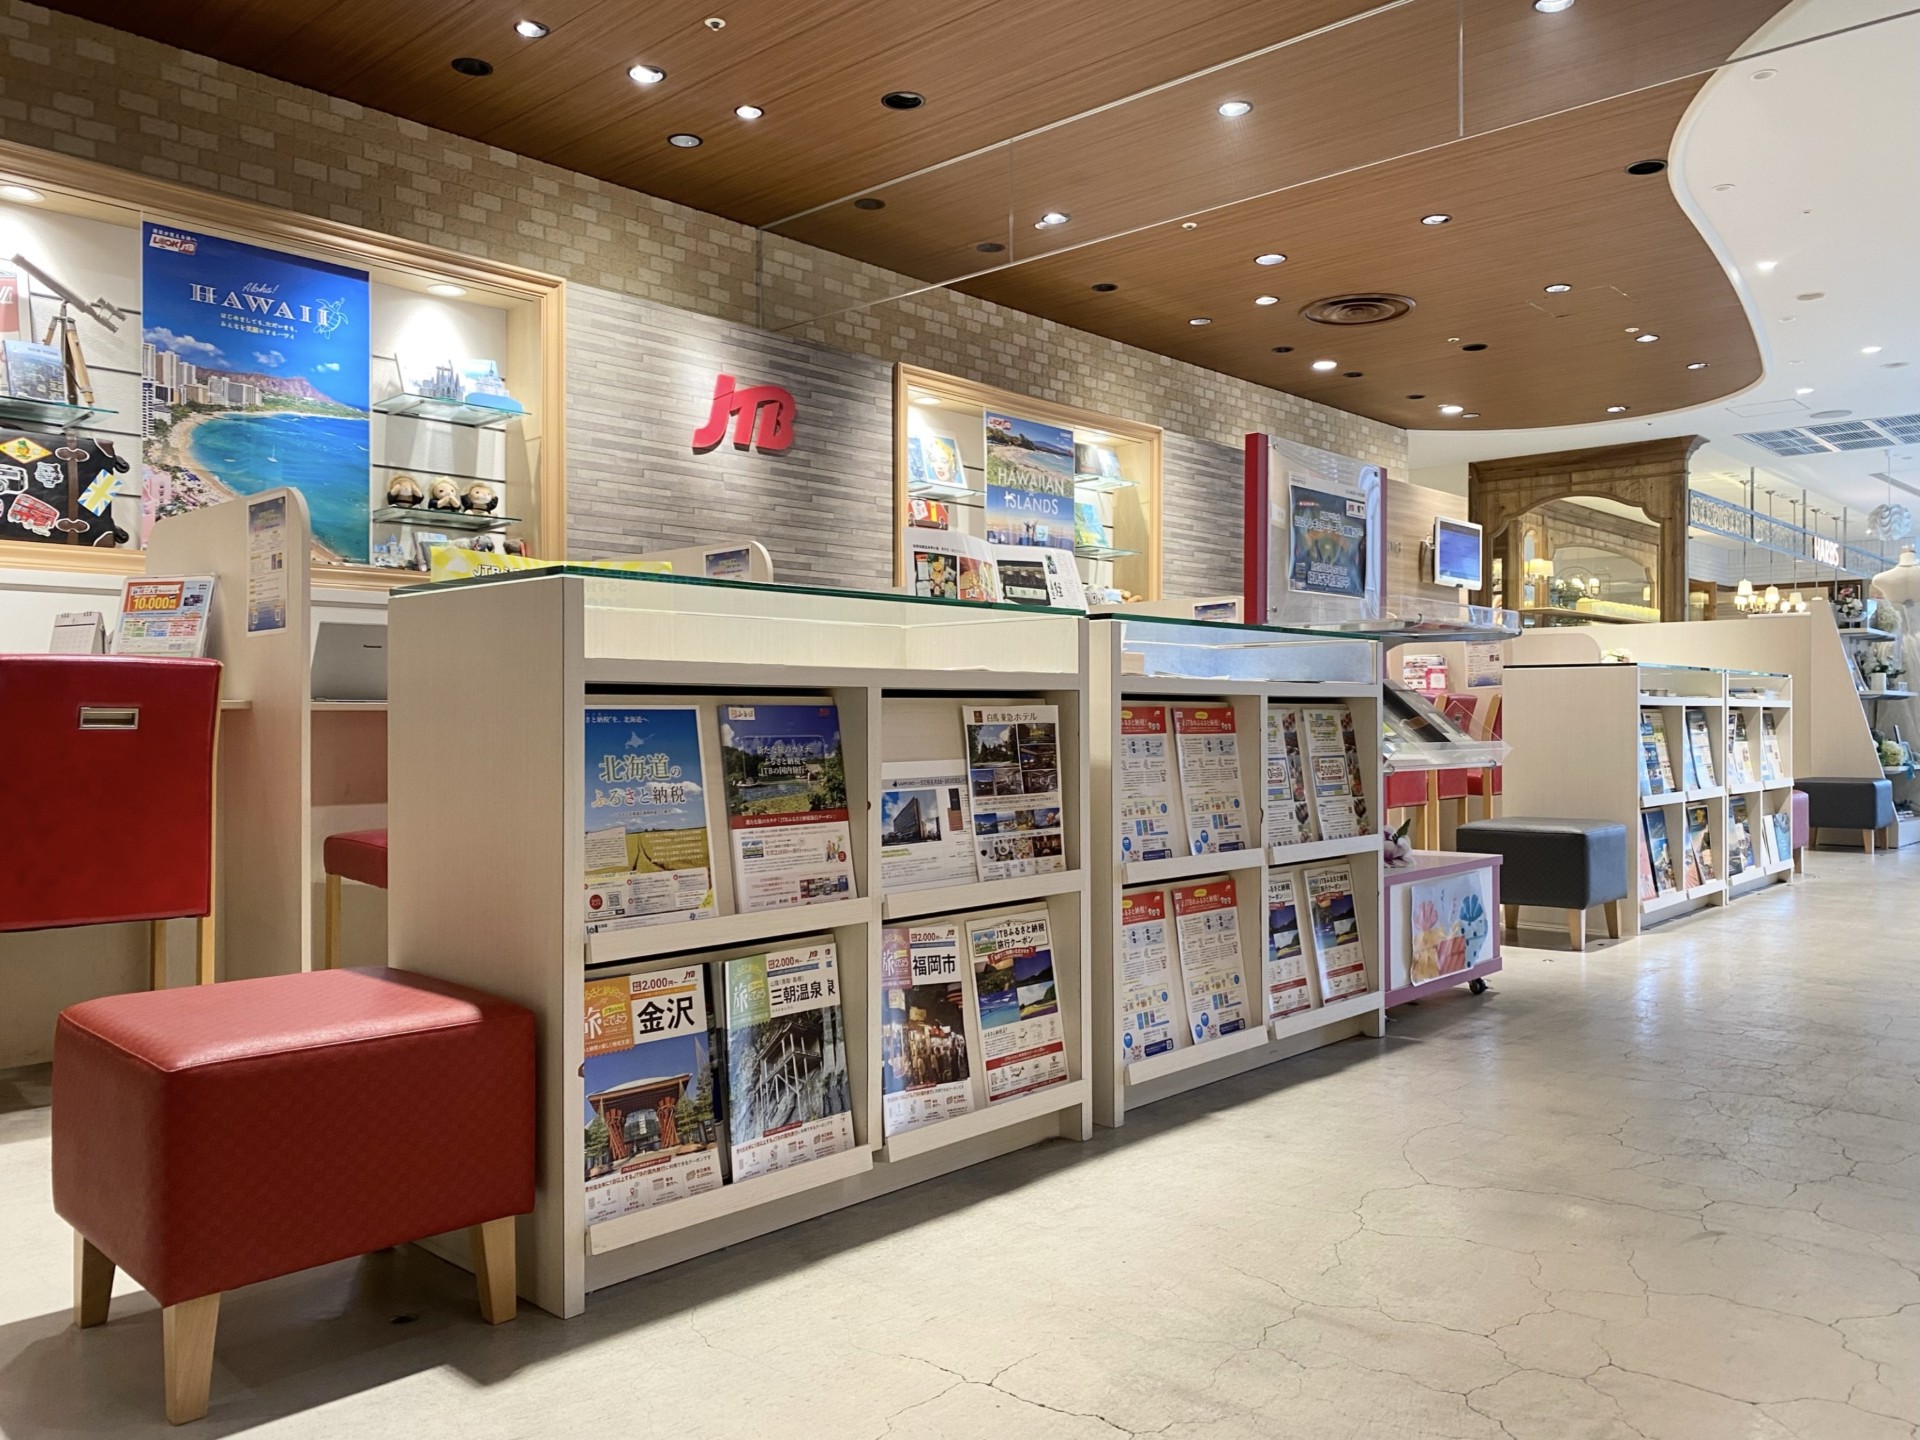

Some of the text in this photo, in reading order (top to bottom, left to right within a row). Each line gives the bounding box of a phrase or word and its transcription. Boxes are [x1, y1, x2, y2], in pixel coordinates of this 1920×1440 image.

[241, 282, 280, 295] Aloha!
[189, 283, 330, 327] HAWAII
[691, 373, 797, 456] JTB
[998, 467, 1065, 496] HAWAIIAN
[1004, 490, 1059, 515] ISLANDS
[1814, 535, 1840, 567] HARBS
[598, 753, 682, 783] 北海道の
[591, 785, 686, 808] ふるさと納税
[996, 923, 1045, 939] JTBふるさと納税
[997, 935, 1034, 949] 旅行クーポン
[809, 950, 818, 959] JTB
[912, 953, 956, 977] 福岡市
[683, 970, 696, 980] JTB
[771, 981, 823, 1006] 三朝温泉
[637, 995, 695, 1036] 金沢
